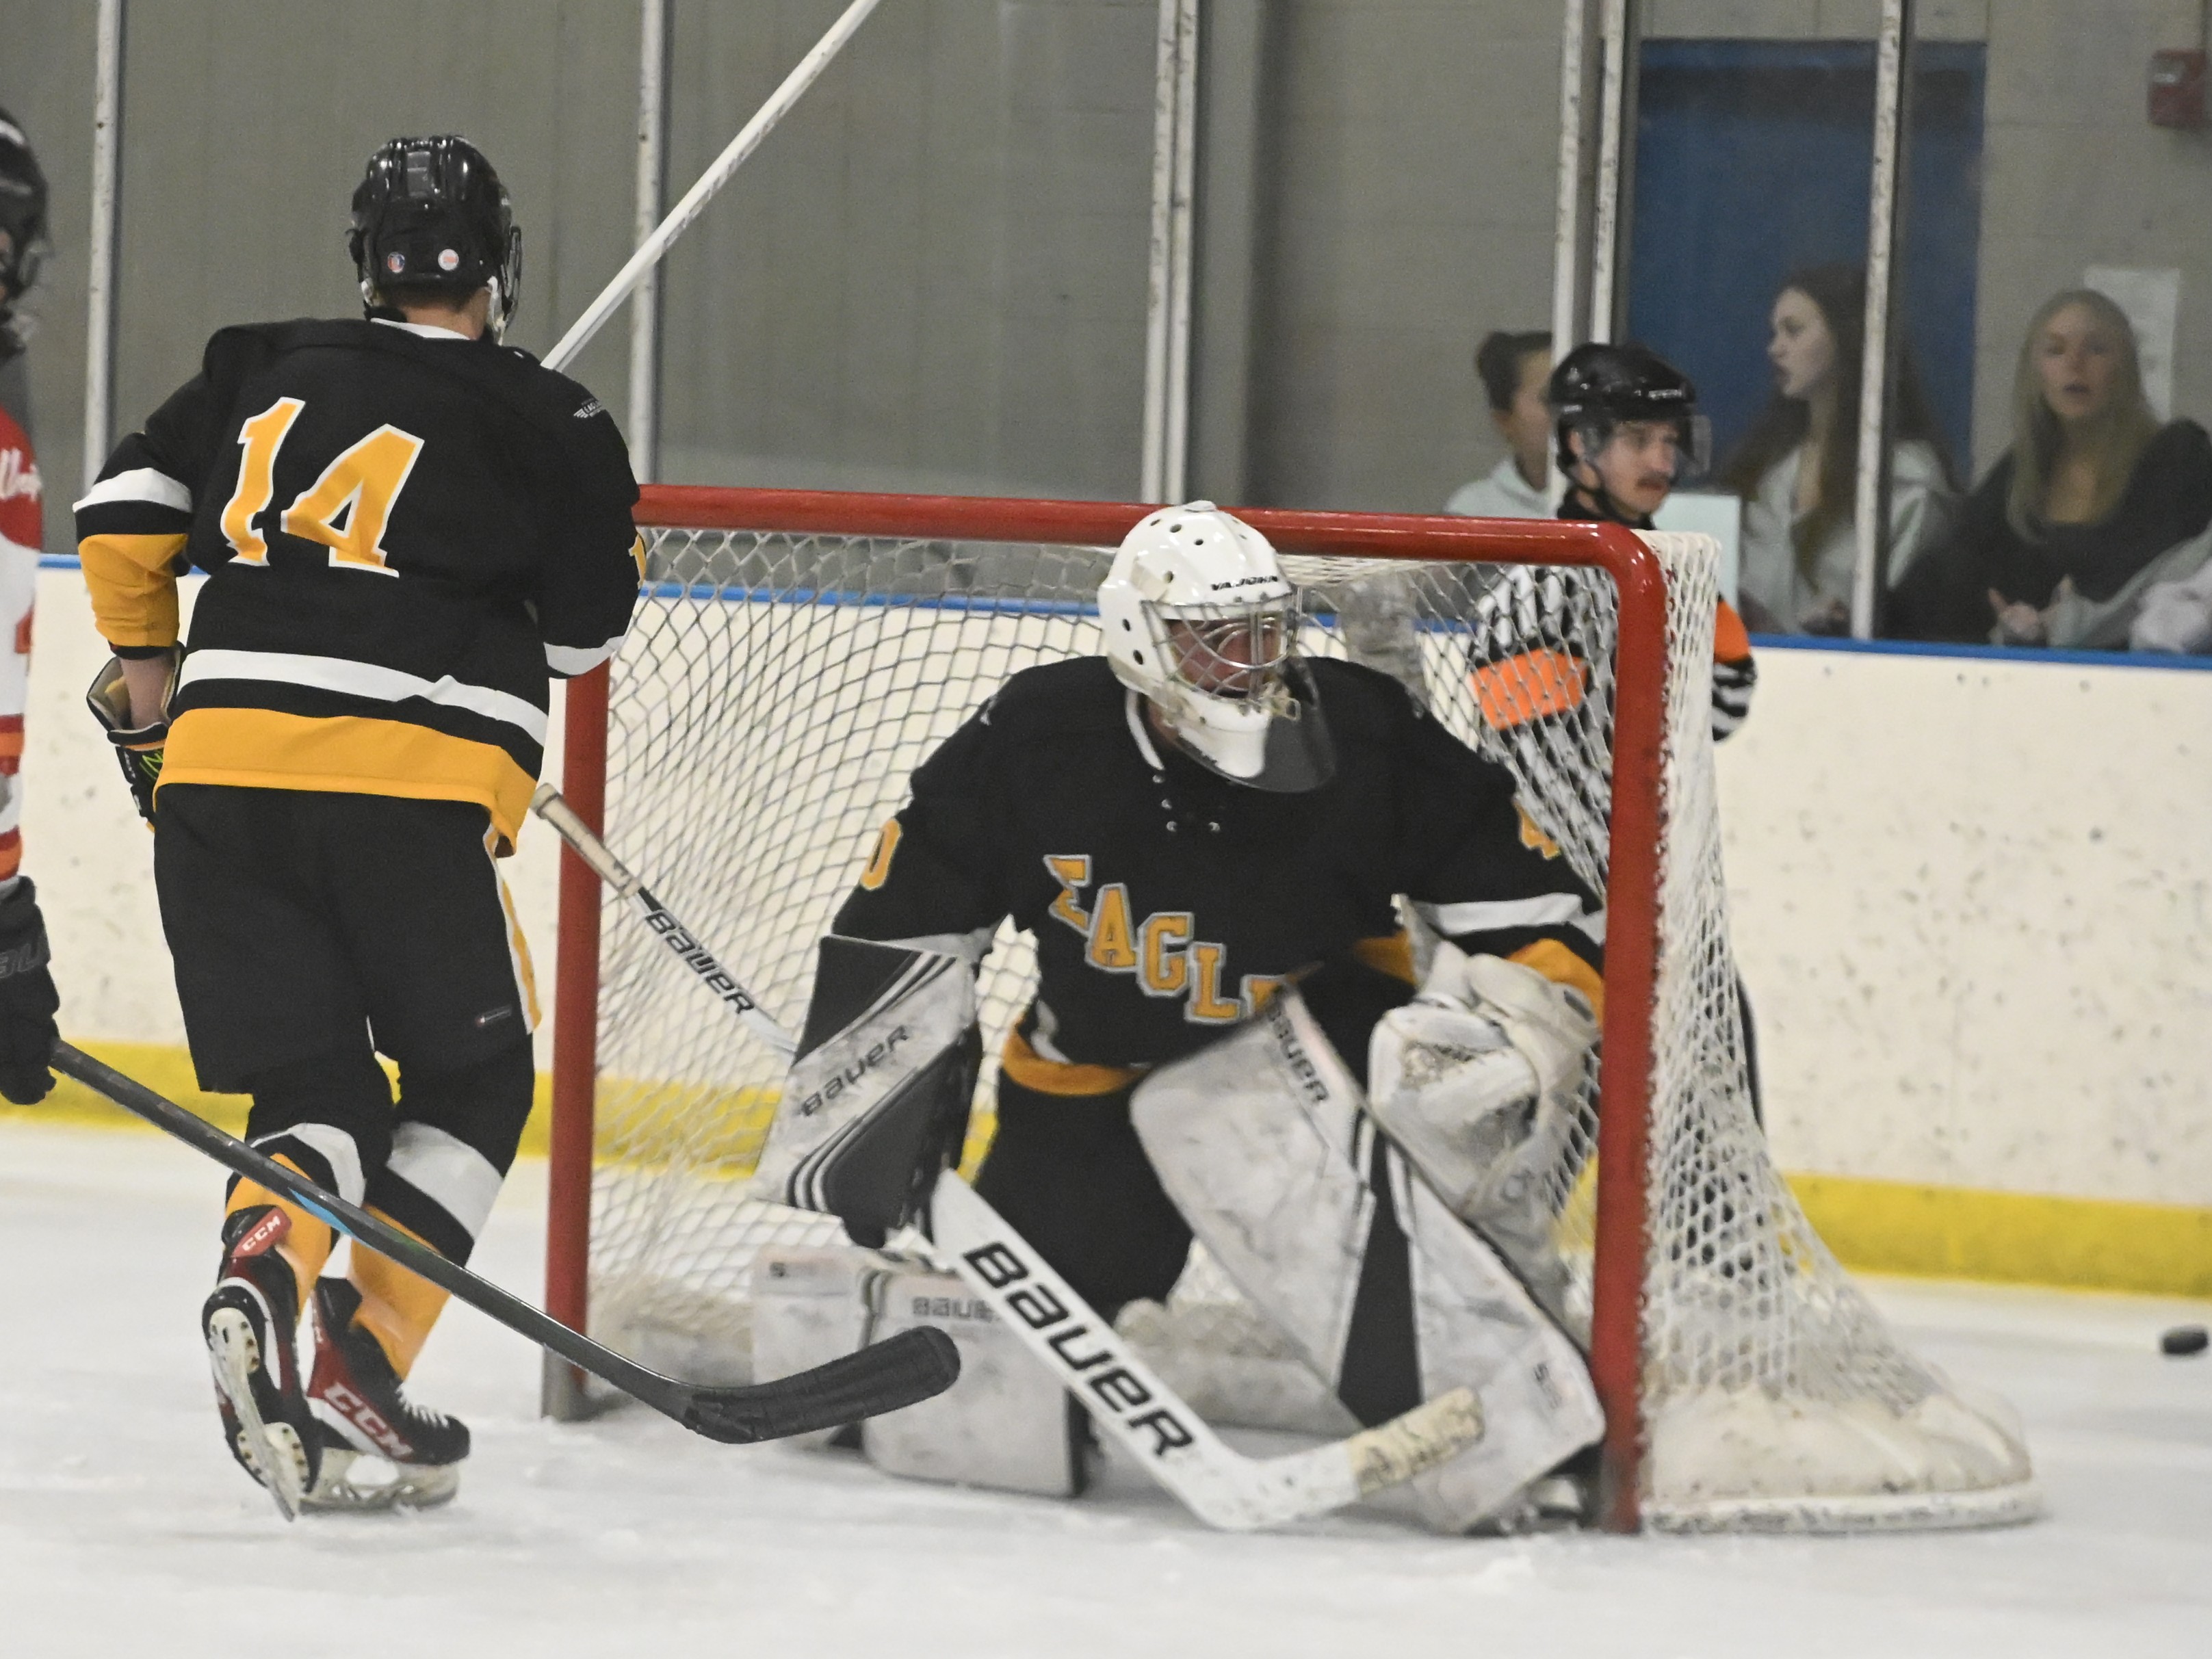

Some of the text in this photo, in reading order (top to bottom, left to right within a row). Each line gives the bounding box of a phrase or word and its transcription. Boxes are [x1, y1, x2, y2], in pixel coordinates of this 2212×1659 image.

[220, 396, 424, 578] 14
[645, 911, 755, 1015] BAUER
[801, 1026, 909, 1116] BAUER
[242, 1216, 281, 1251] CCM
[962, 1242, 1195, 1456] BAUER
[324, 1382, 413, 1456] CCM
